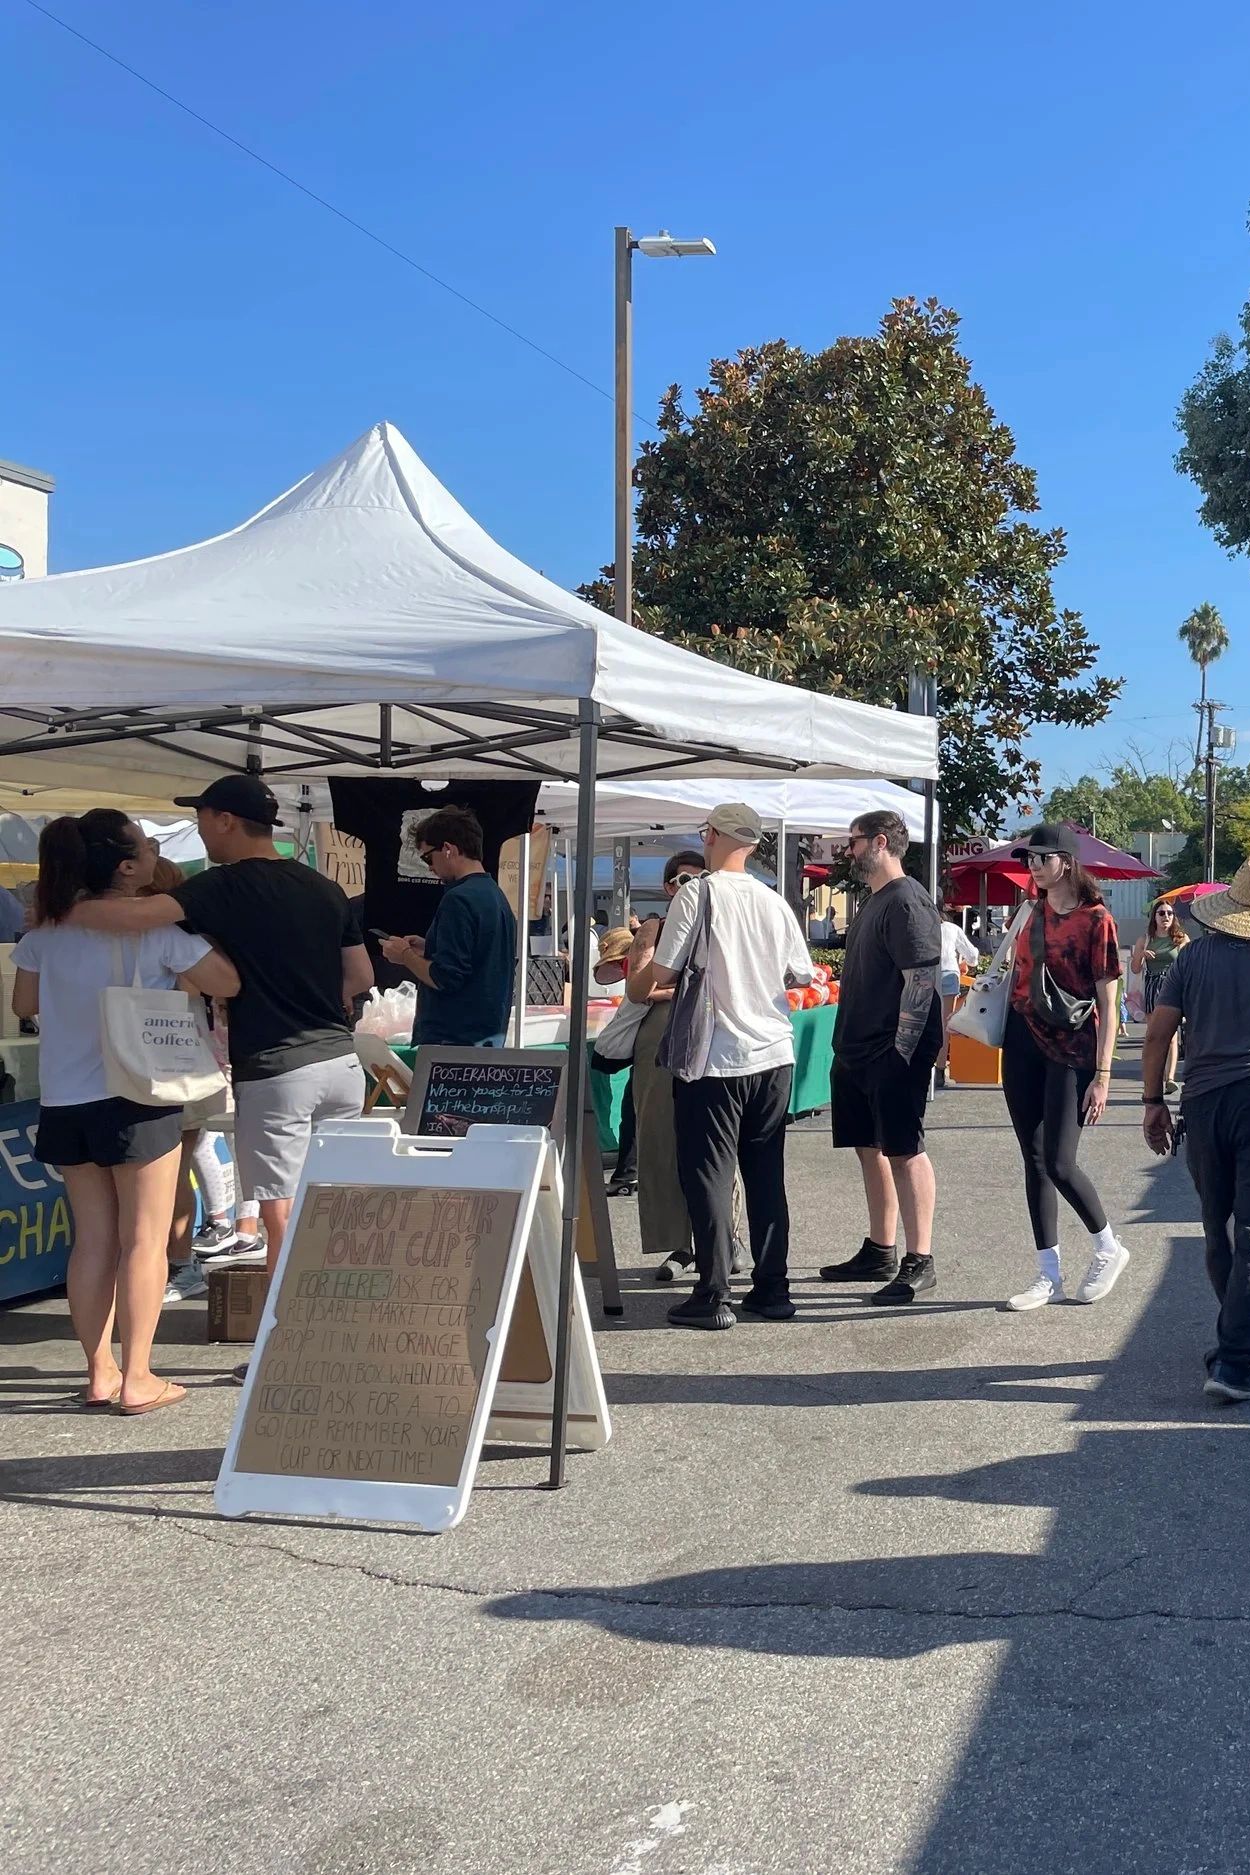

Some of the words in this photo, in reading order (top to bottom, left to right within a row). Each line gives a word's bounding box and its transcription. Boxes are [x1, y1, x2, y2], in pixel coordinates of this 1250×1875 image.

[429, 1083, 466, 1097] When
[308, 1192, 418, 1231] FORGOT
[430, 1192, 499, 1234] YOUR
[327, 1231, 396, 1266] OWN
[406, 1232, 481, 1268] CUP?
[299, 1272, 329, 1297] FOR
[391, 1275, 424, 1299] ASK
[431, 1276, 459, 1300] FOR
[470, 1276, 481, 1299] A
[287, 1299, 362, 1323] REUSABLE
[369, 1302, 429, 1327] MARKET
[271, 1329, 315, 1351] DROP
[322, 1330, 337, 1351] IT
[342, 1331, 359, 1353] IN
[368, 1332, 387, 1353] AN
[396, 1331, 462, 1357] ORANGE
[263, 1359, 351, 1384] COLLECTION
[355, 1362, 382, 1385] BOX
[390, 1362, 432, 1385] WHEN
[262, 1387, 288, 1411] TO
[323, 1391, 354, 1415] ASK
[367, 1392, 400, 1417] FOR
[407, 1394, 421, 1418] A
[434, 1395, 461, 1419] TO
[255, 1416, 280, 1438] GO
[327, 1420, 411, 1445] REMEMBER
[421, 1425, 462, 1448] YOUR
[280, 1444, 309, 1470] CUP
[317, 1447, 341, 1472] FOR
[349, 1449, 384, 1472] NEXT
[390, 1449, 433, 1475] TIME!
